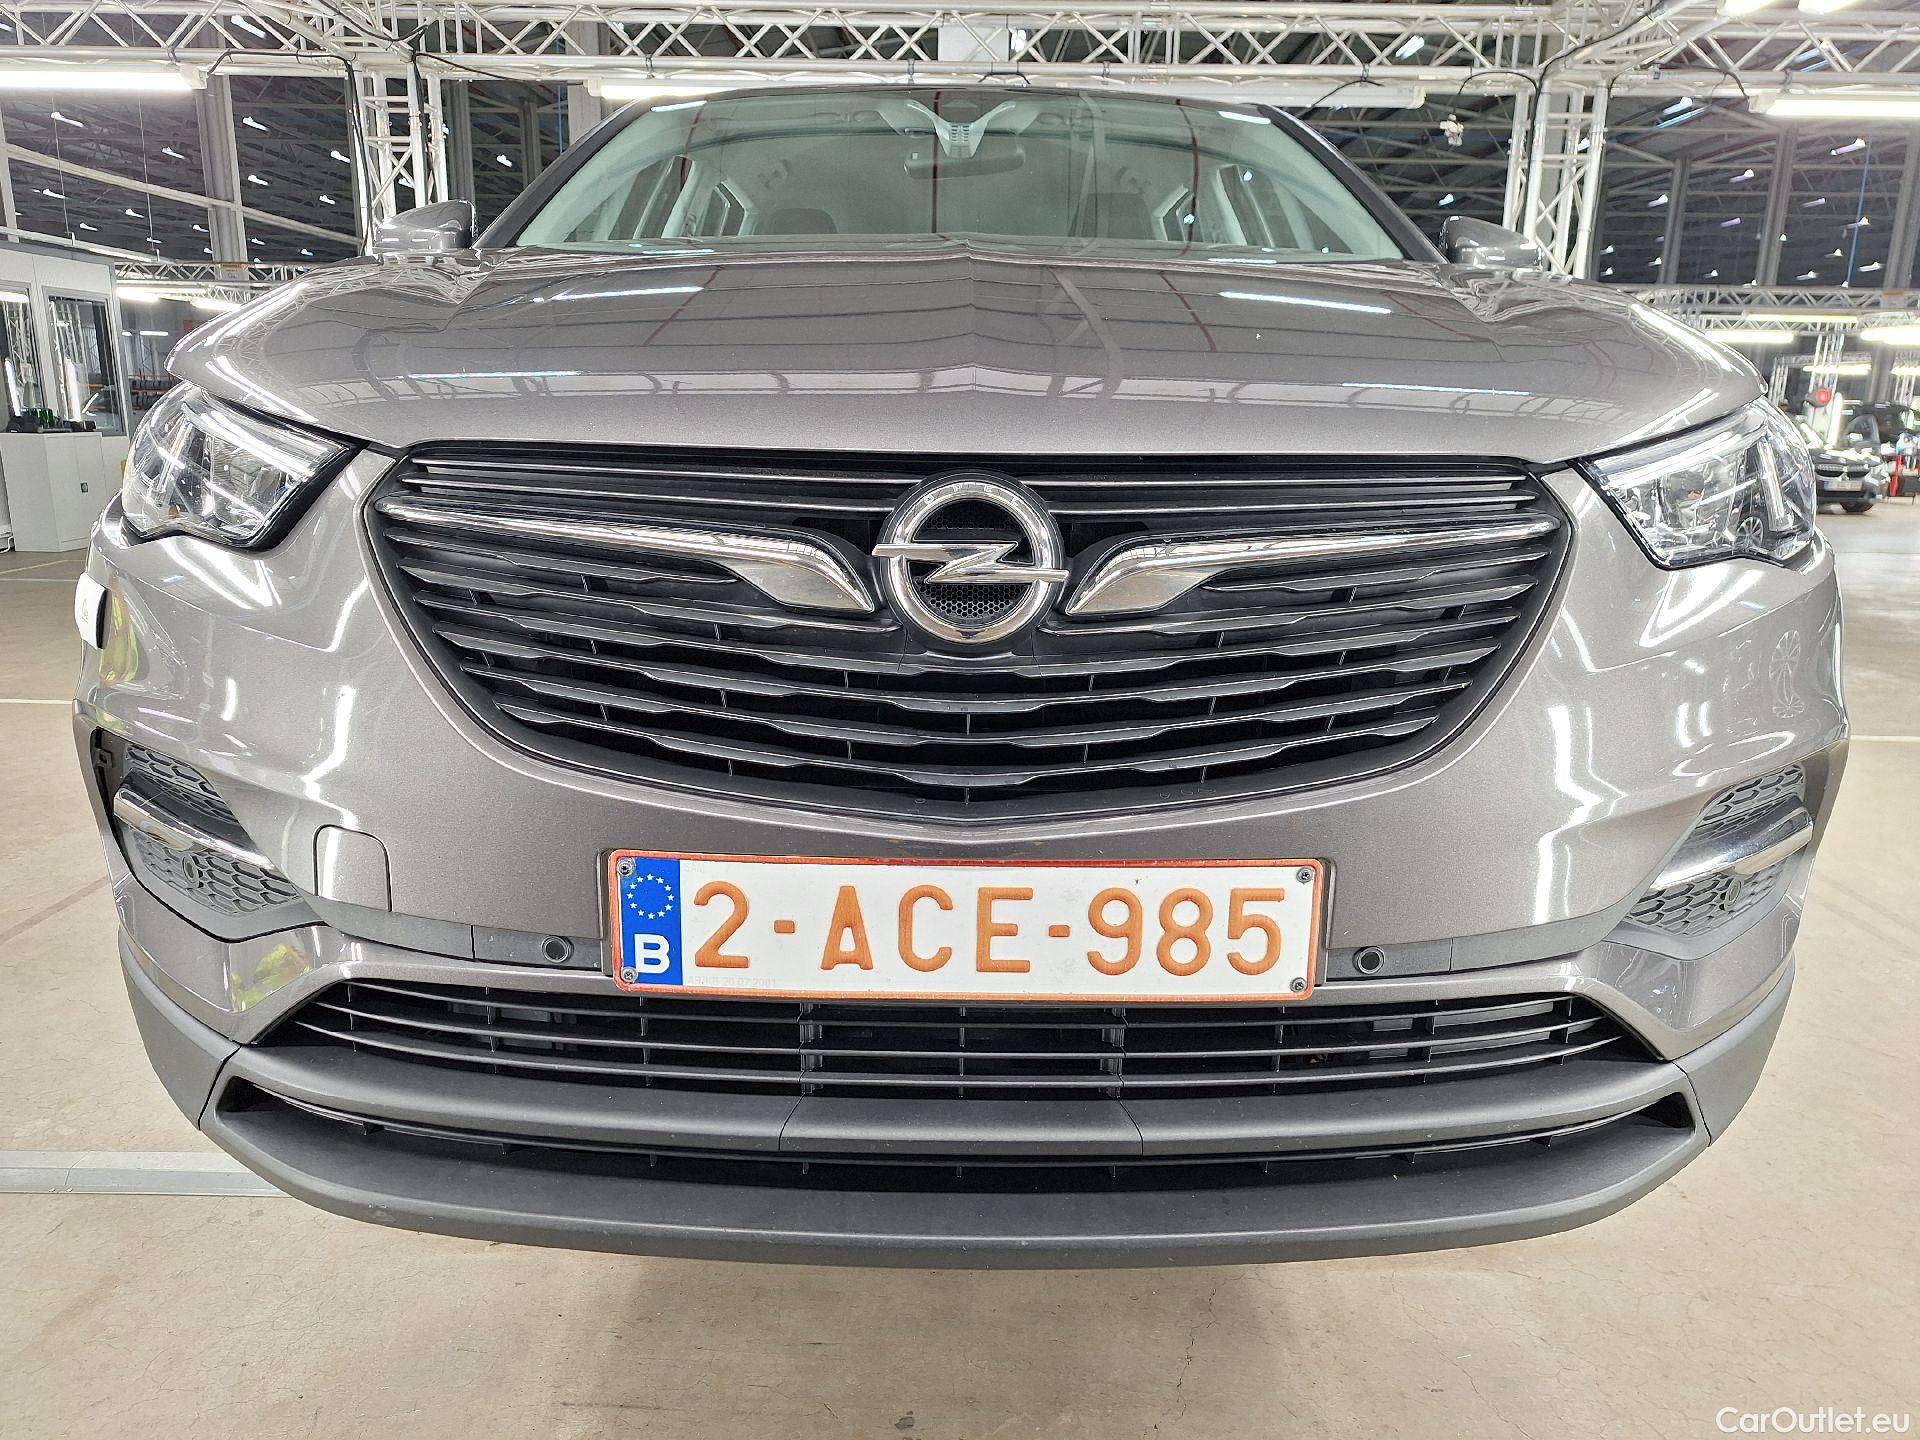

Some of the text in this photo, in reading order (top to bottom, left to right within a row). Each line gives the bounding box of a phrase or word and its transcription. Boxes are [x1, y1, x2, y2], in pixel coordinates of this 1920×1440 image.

[923, 483, 1020, 507] OPEL
[693, 879, 1286, 977] 2-ACE-985
[634, 933, 670, 974] B
